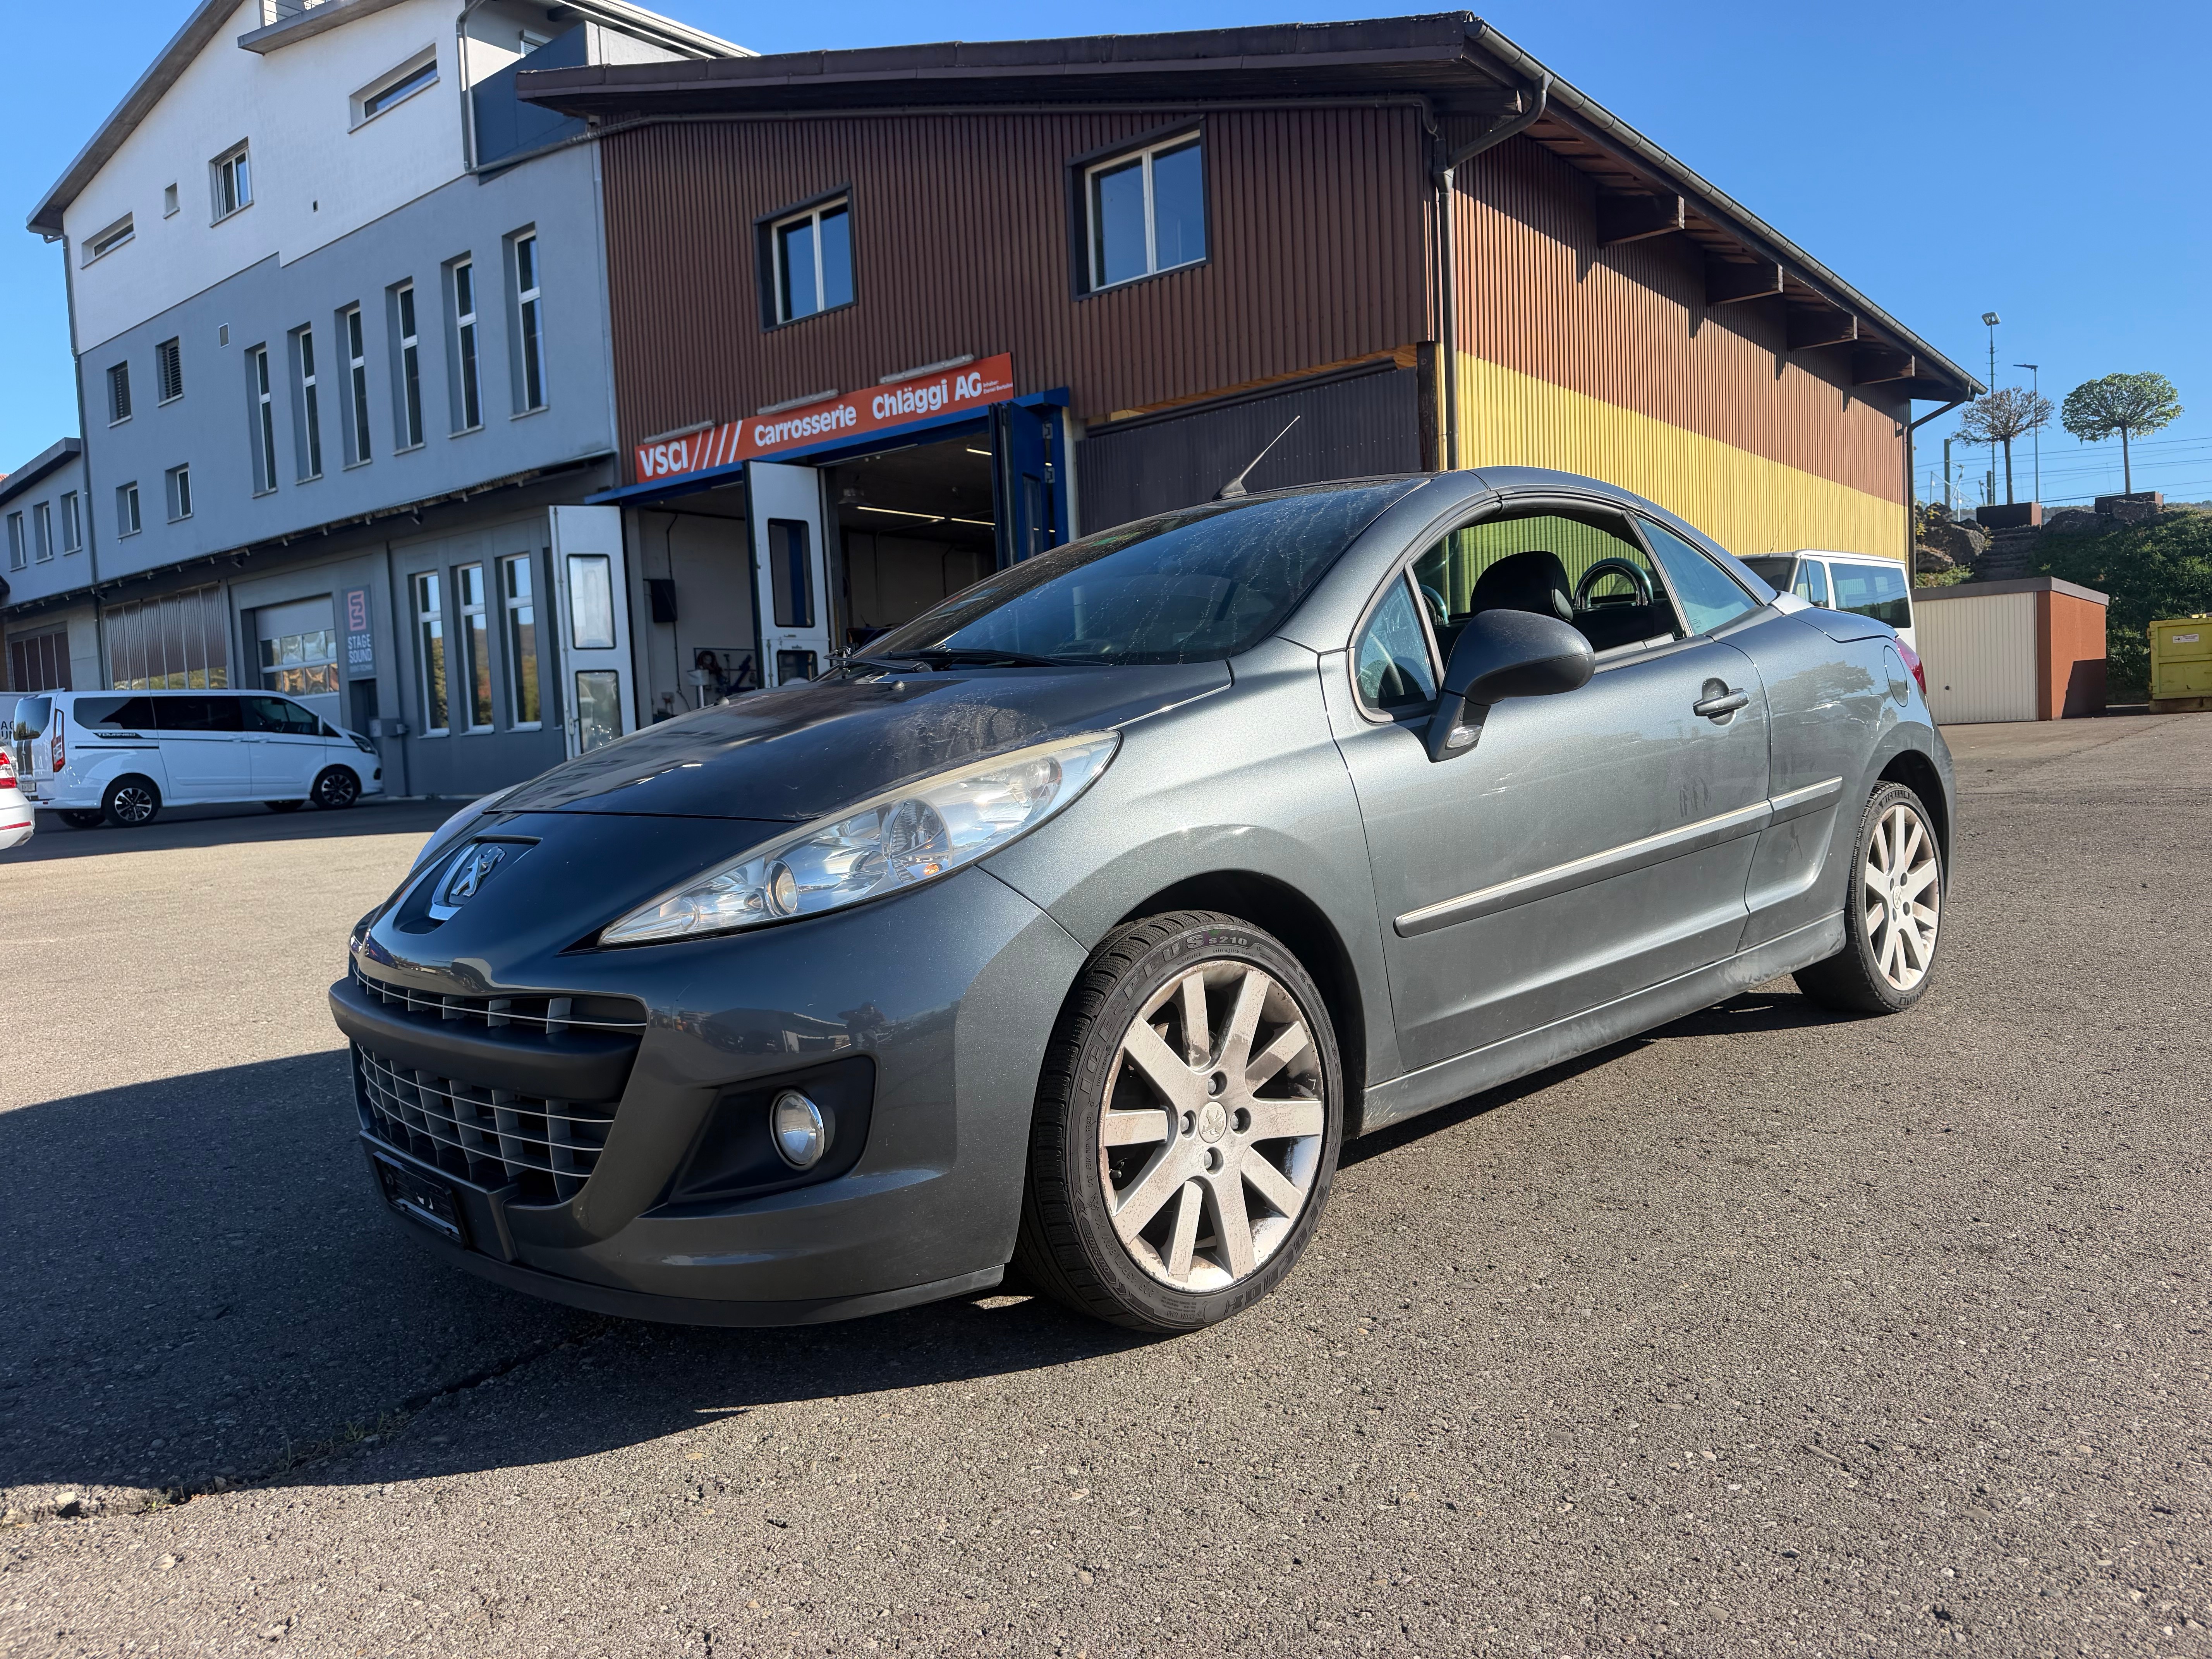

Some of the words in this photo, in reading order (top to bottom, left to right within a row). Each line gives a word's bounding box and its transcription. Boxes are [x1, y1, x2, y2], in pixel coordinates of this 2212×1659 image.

[640, 440, 688, 477] VSCI
[755, 404, 856, 447] Carrosserie
[872, 379, 947, 419] Chläggi
[955, 372, 982, 398] AG
[348, 634, 371, 650] STAGE
[349, 648, 373, 664] SOUND
[1085, 1231, 1110, 1273] OUTSIDE
